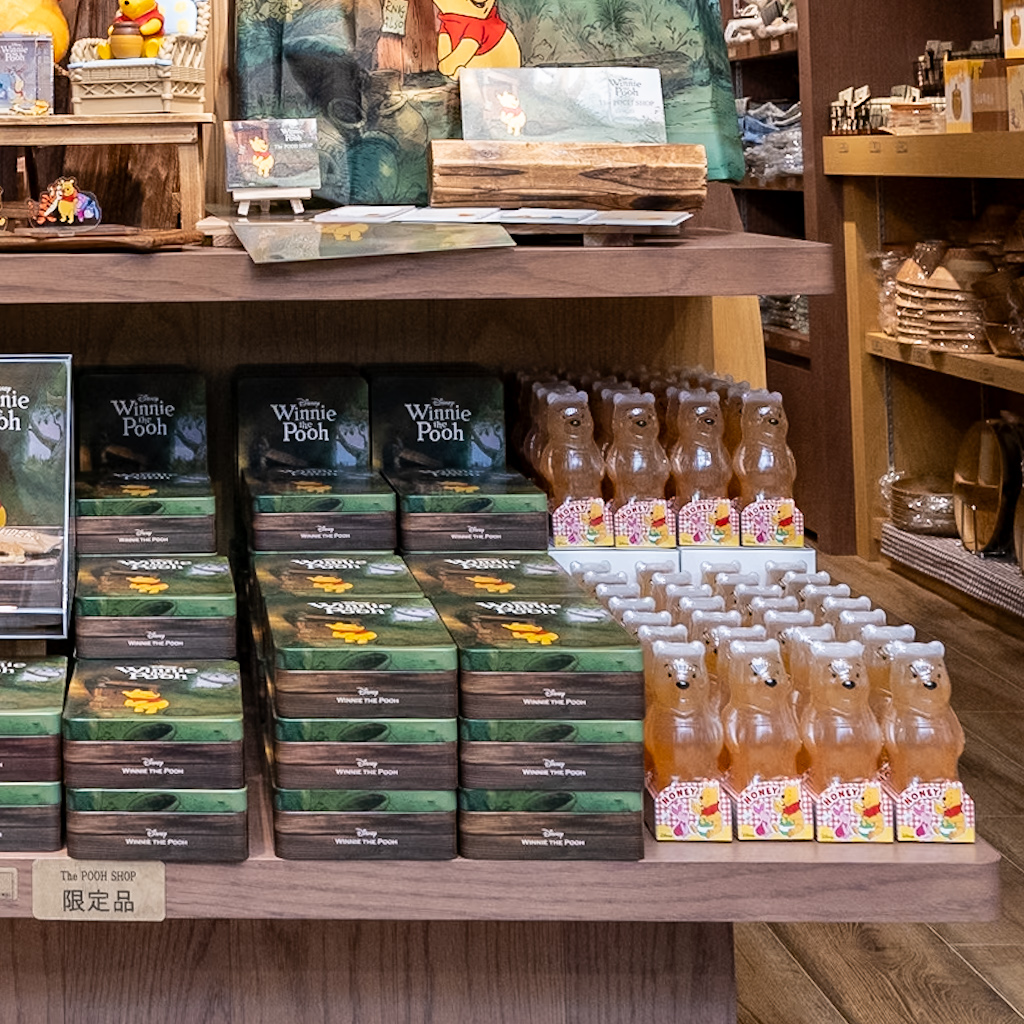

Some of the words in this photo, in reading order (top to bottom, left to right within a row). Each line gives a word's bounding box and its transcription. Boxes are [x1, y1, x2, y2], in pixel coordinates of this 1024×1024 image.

[110, 399, 175, 418] Winnie
[270, 403, 337, 422] Winnie
[404, 403, 471, 422] Winnie
[123, 415, 167, 438] Pooh
[283, 422, 329, 442] Pooh
[417, 422, 464, 442] Pooh
[128, 639, 151, 647] WINNIE
[165, 639, 183, 647] POOH
[336, 696, 362, 704] WINNIE
[378, 696, 399, 704] POOH
[121, 767, 147, 775] WINNIE
[163, 767, 184, 775] POOH
[662, 787, 696, 805] HONEY
[744, 787, 778, 804] HONEY
[824, 788, 858, 806] HONEY
[904, 789, 939, 805] HONEY
[521, 838, 548, 846] WINNIE
[564, 838, 585, 846] POOH
[60, 870, 78, 881] The
[81, 870, 107, 881] POOH
[111, 870, 137, 882] SHOP
[63, 889, 135, 913] 限定品
